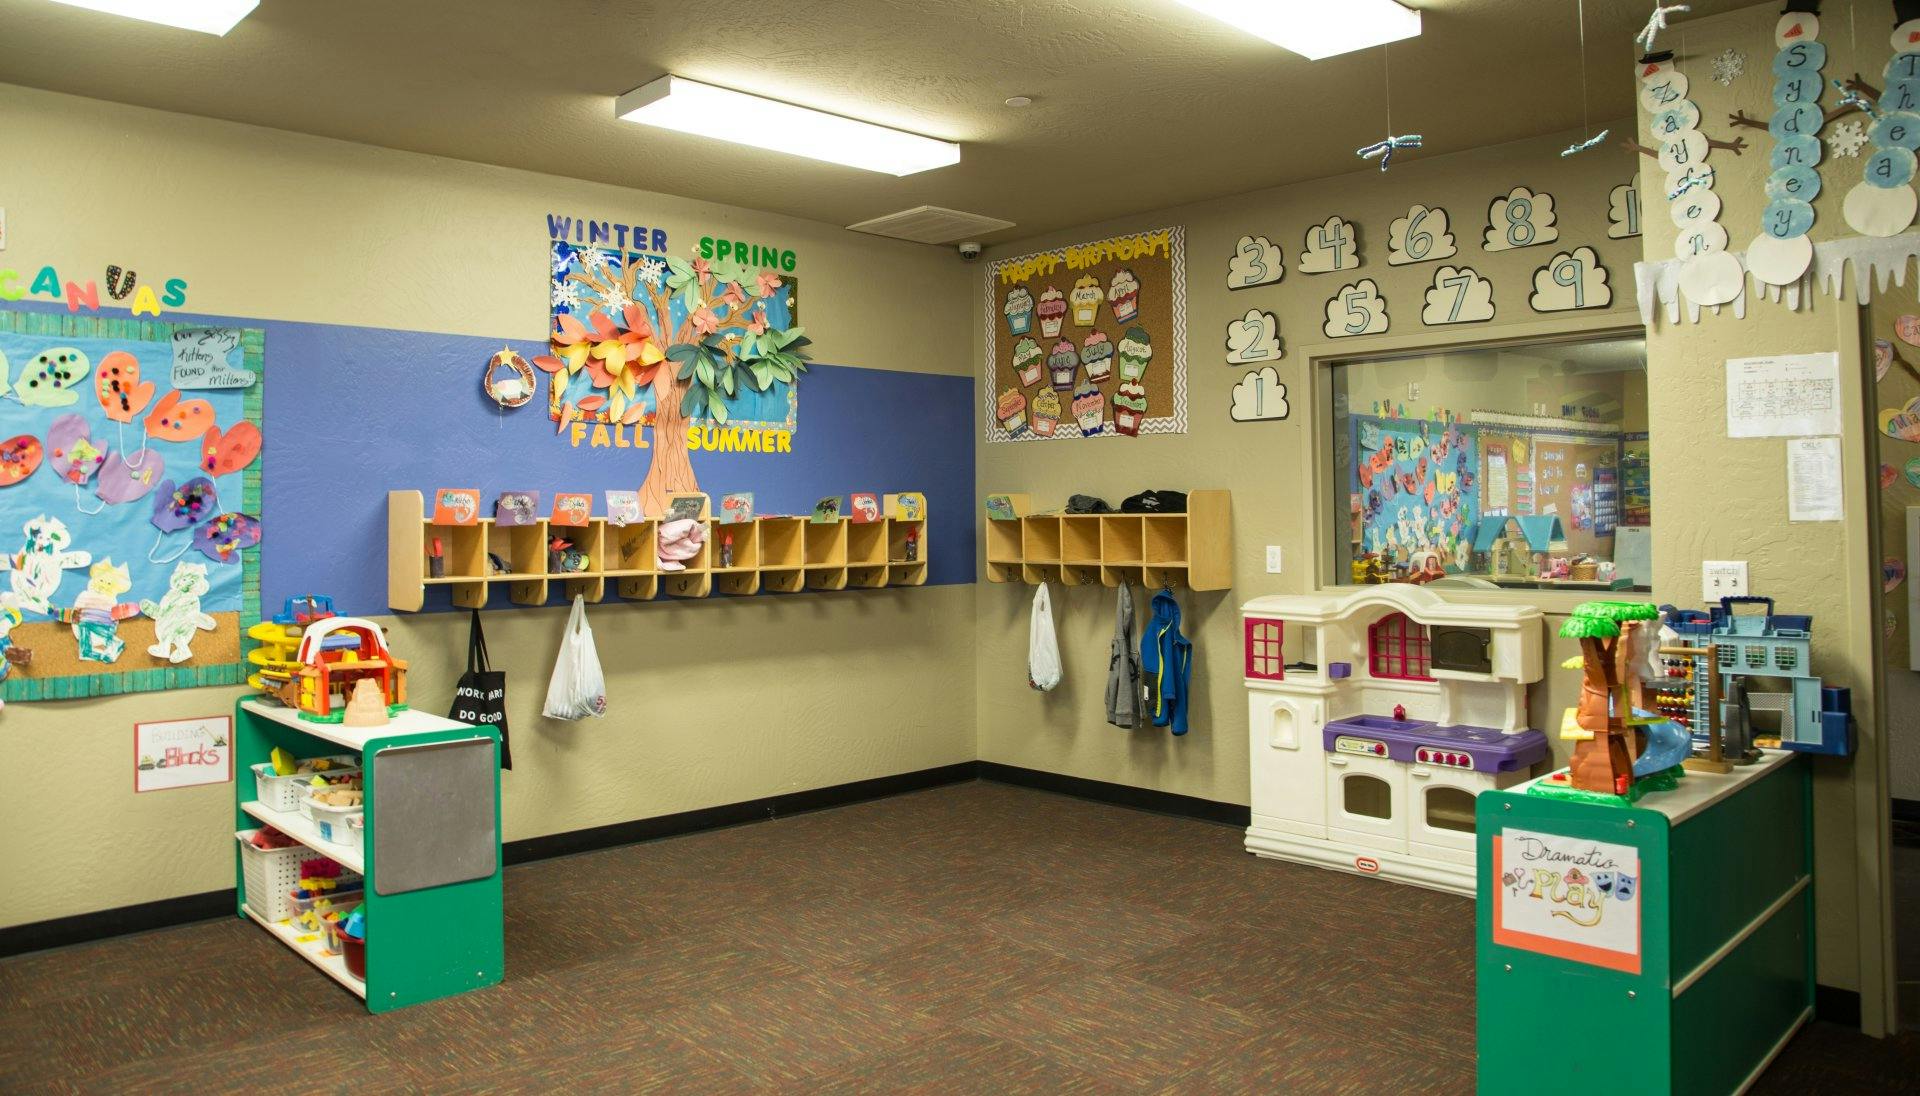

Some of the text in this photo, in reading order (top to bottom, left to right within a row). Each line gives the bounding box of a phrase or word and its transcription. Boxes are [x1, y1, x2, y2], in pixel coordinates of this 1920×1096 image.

[1773, 44, 1807, 238] Sydney
[546, 213, 668, 253] WINTER
[1404, 209, 1434, 260] 6
[1505, 197, 1536, 247] 8
[699, 235, 797, 273] SPRING
[1243, 242, 1268, 285] 3
[1318, 223, 1347, 270] 4
[0, 264, 188, 317] CANVAS
[1000, 254, 1060, 285] HAPPY
[1552, 258, 1585, 308] 9
[1344, 291, 1372, 334] 5
[1443, 275, 1472, 322] 7
[1240, 319, 1269, 360] 2
[1255, 377, 1264, 417] 1
[570, 422, 651, 449] FALL
[686, 425, 793, 454] SUMMER
[459, 709, 476, 721] DO
[1515, 836, 1619, 870] Dramatic
[1528, 866, 1608, 928] Play
